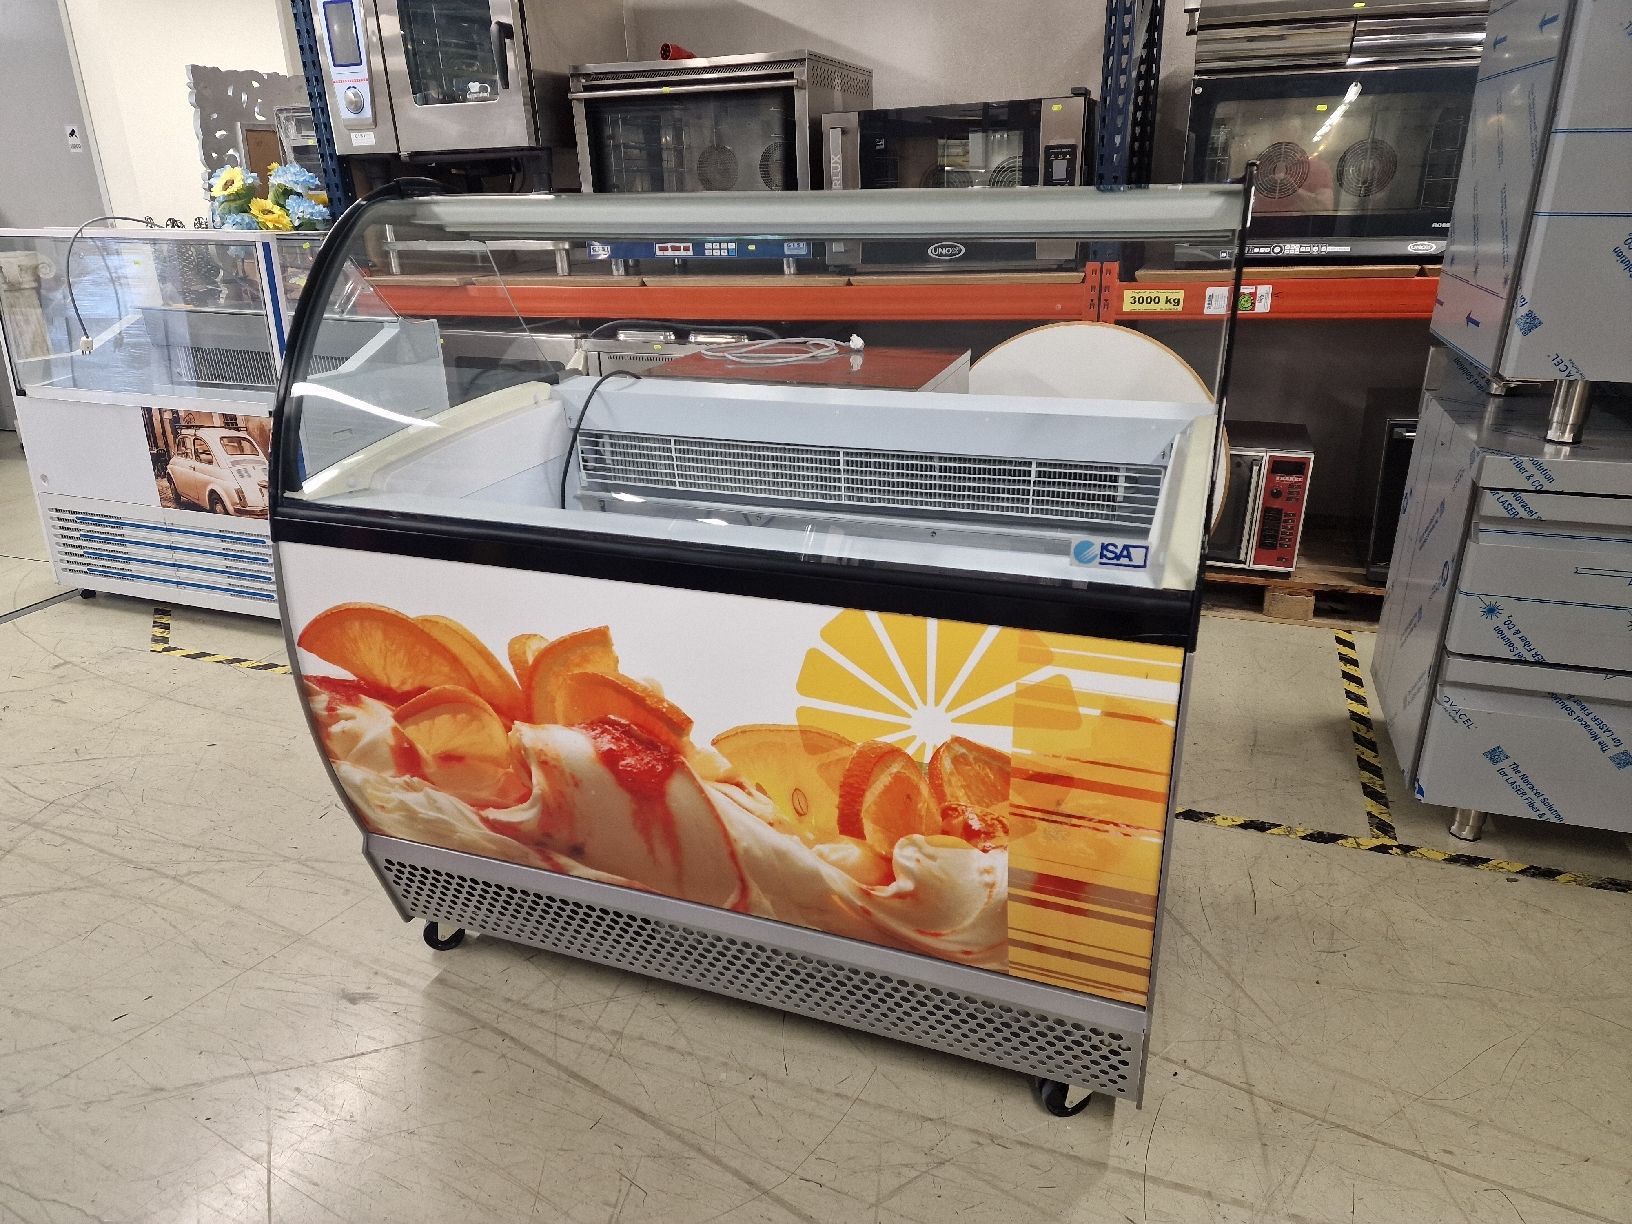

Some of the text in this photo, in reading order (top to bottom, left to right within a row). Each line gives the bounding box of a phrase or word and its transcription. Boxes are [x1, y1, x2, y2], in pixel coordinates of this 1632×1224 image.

[932, 246, 960, 255] UNOX
[1130, 295, 1181, 307] 3000 kg
[1525, 473, 1535, 481] &
[1099, 542, 1134, 562] ISA
[1493, 625, 1519, 653] Solution
[1518, 635, 1537, 653] Fiber
[1572, 715, 1602, 742] Novacel
[1496, 766, 1509, 778] for
[1504, 775, 1528, 798] LASER
[1523, 795, 1541, 814] Fiber
[1508, 761, 1522, 775] The
[1518, 773, 1545, 799] Novacel
